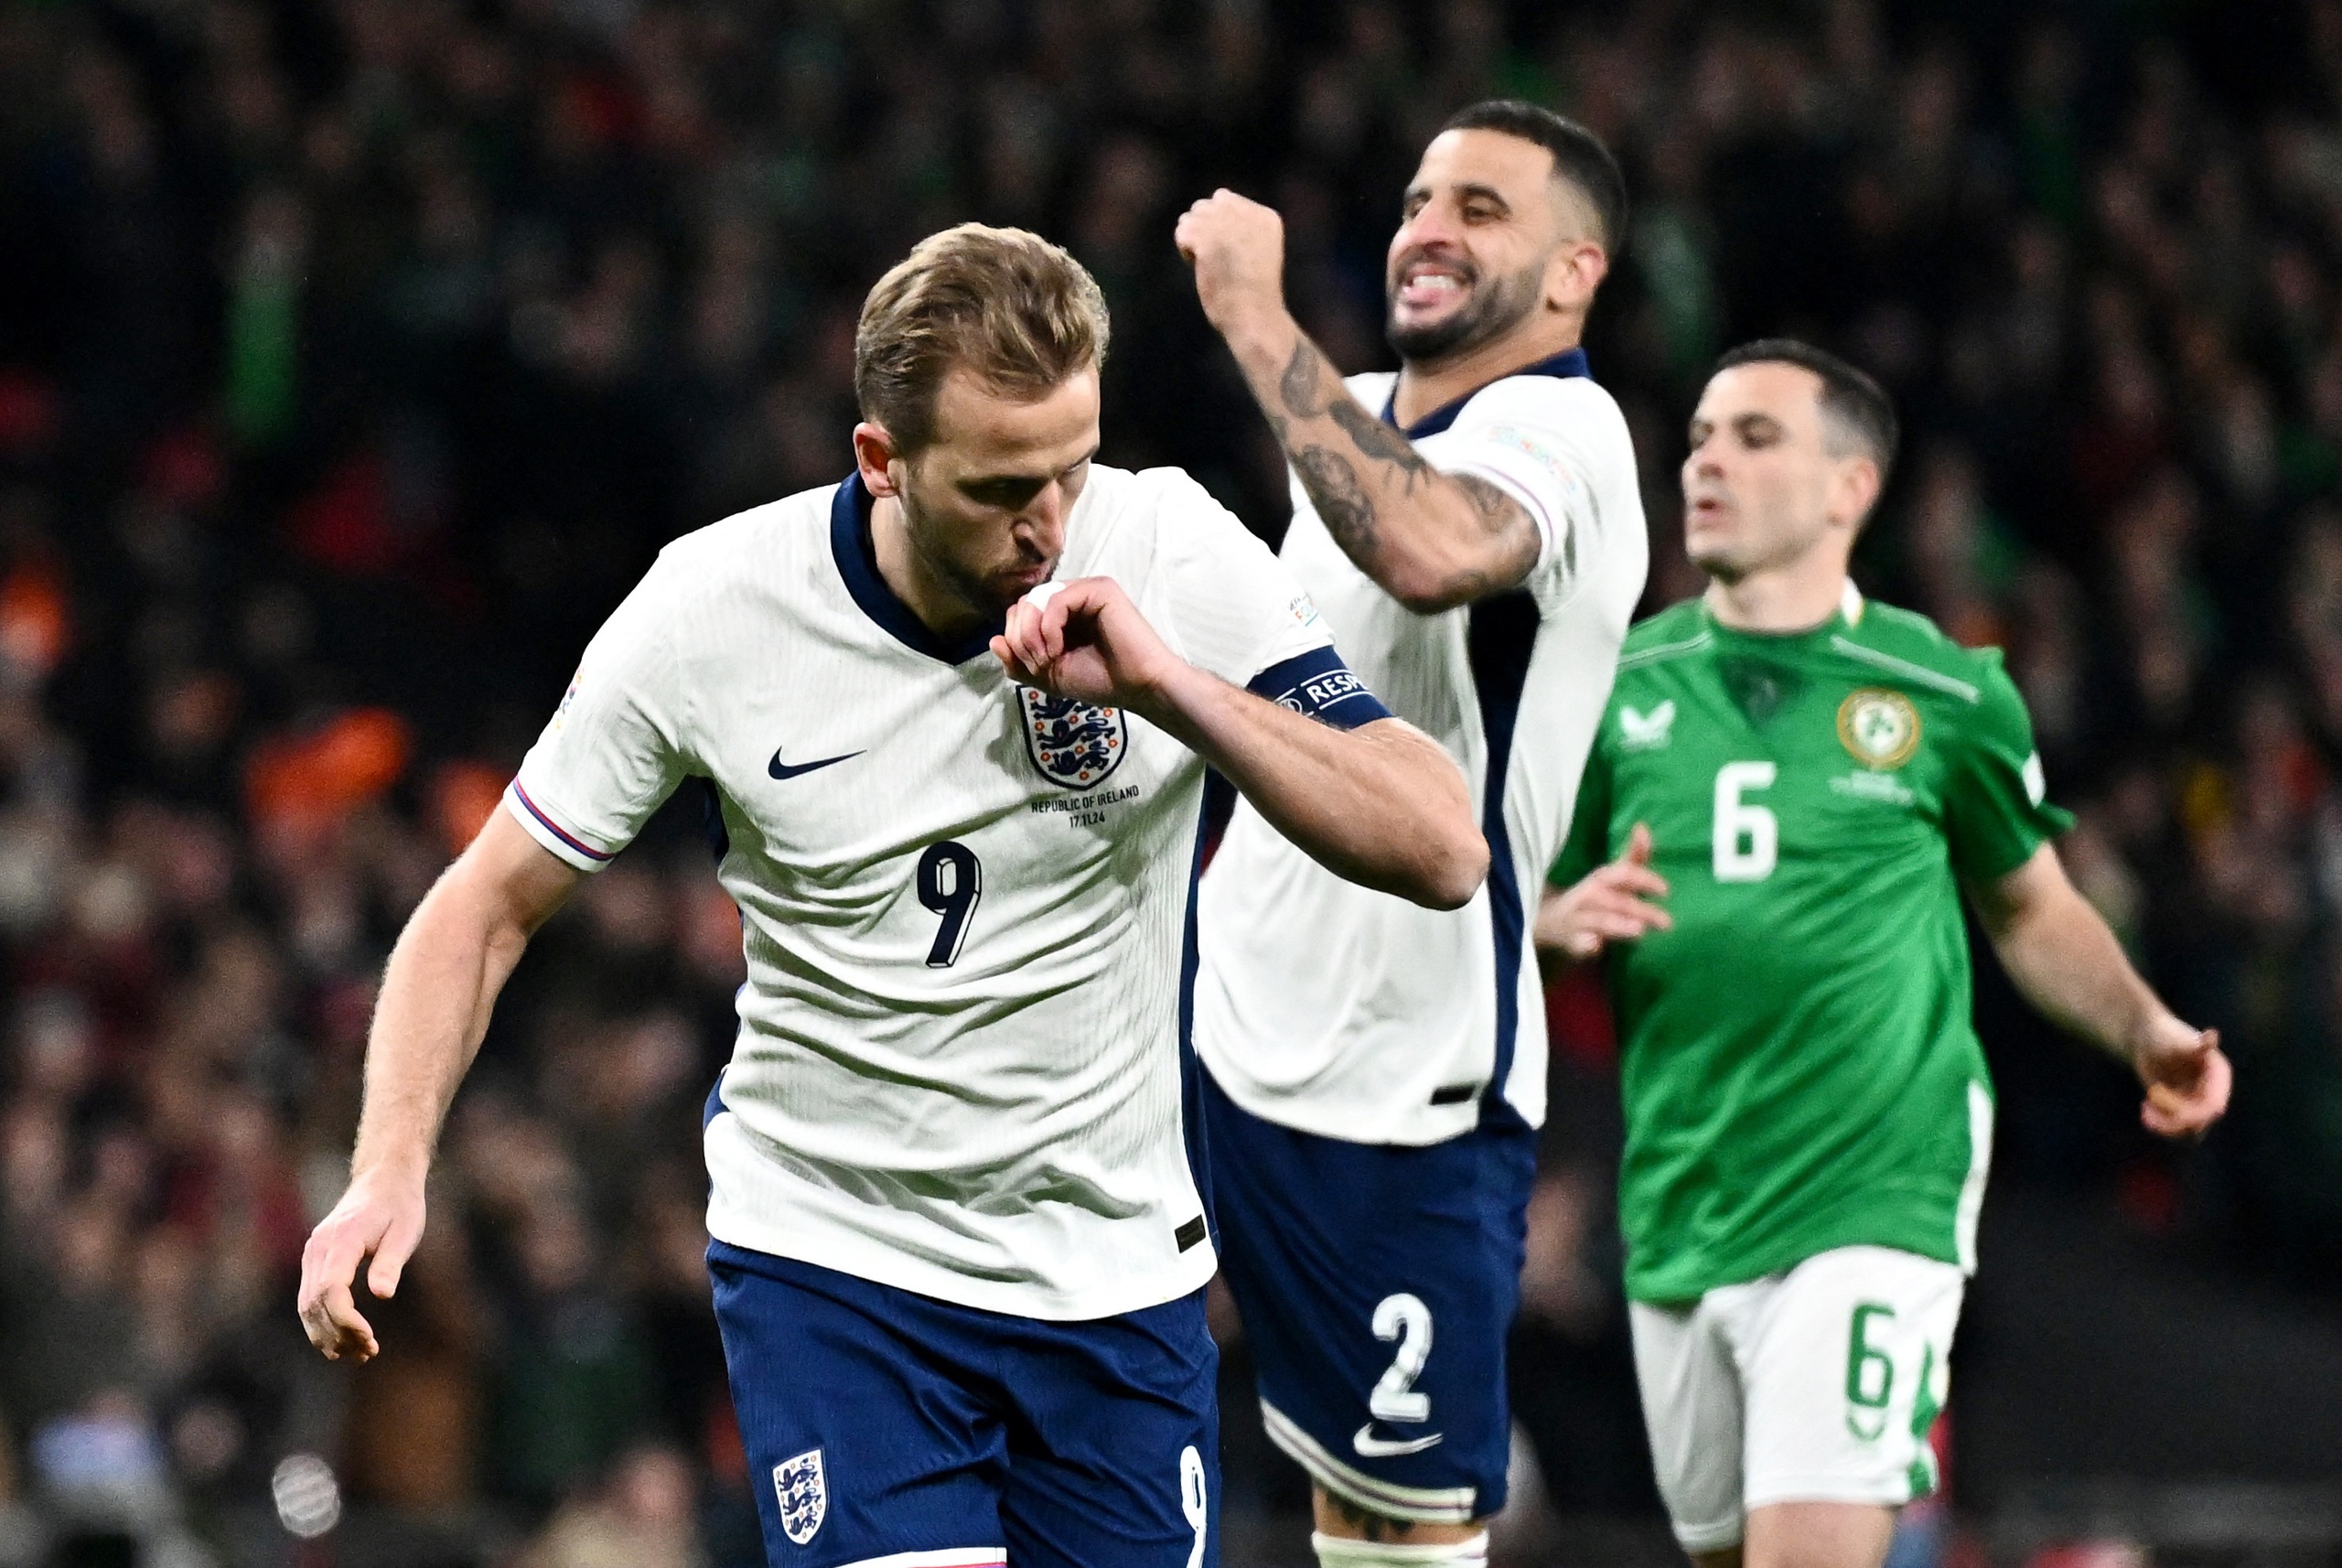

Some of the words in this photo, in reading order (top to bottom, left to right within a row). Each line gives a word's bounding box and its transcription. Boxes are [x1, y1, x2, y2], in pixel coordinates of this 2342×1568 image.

[1031, 799, 1080, 813] REPUBLIC
[1082, 795, 1096, 810] OF
[1097, 785, 1140, 806] IRELAND
[1069, 811, 1106, 828] 17.11.24
[1713, 761, 1778, 883] 6
[918, 841, 983, 969] 9
[1370, 1293, 1434, 1423] 2
[1846, 1303, 1896, 1409] 6
[1179, 1444, 1208, 1568] 9
